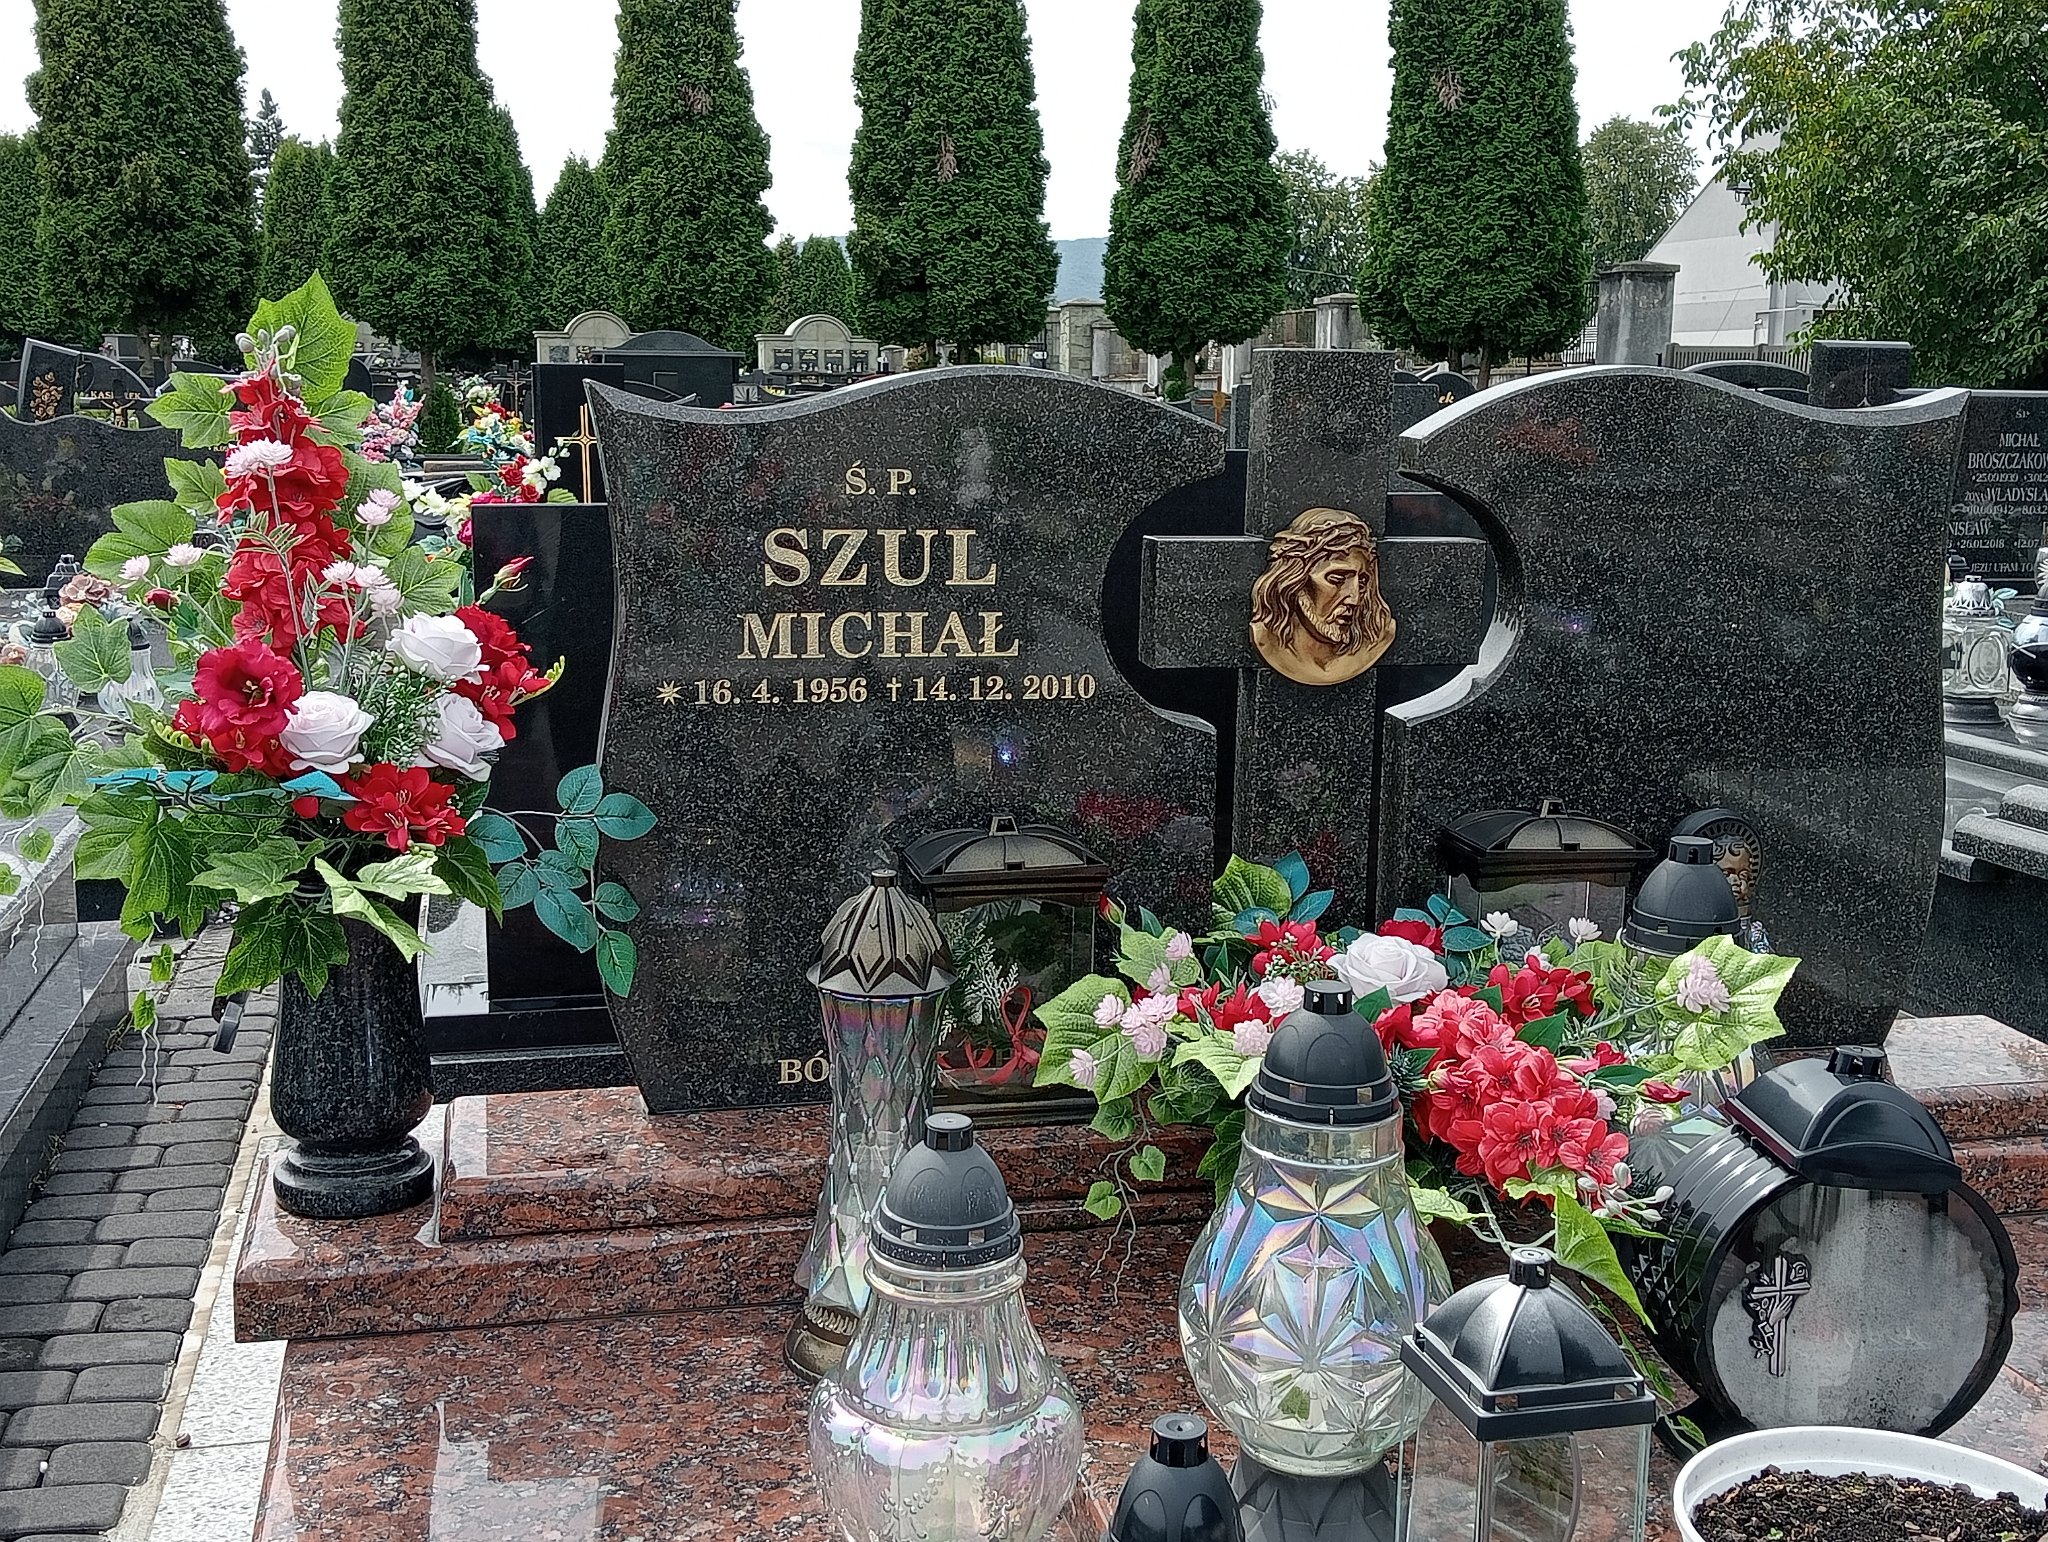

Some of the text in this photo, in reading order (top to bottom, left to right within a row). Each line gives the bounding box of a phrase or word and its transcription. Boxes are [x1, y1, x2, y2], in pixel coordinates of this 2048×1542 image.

[845, 460, 917, 496] Ś. P.
[763, 526, 997, 588] SZUL
[736, 610, 1020, 660] MICHAŁ
[693, 678, 741, 705] 16.
[751, 678, 781, 704] 4.
[791, 676, 869, 703] 1956
[968, 675, 1013, 700] 12.
[1023, 673, 1097, 699] 2010
[777, 1050, 830, 1086] BÓ
